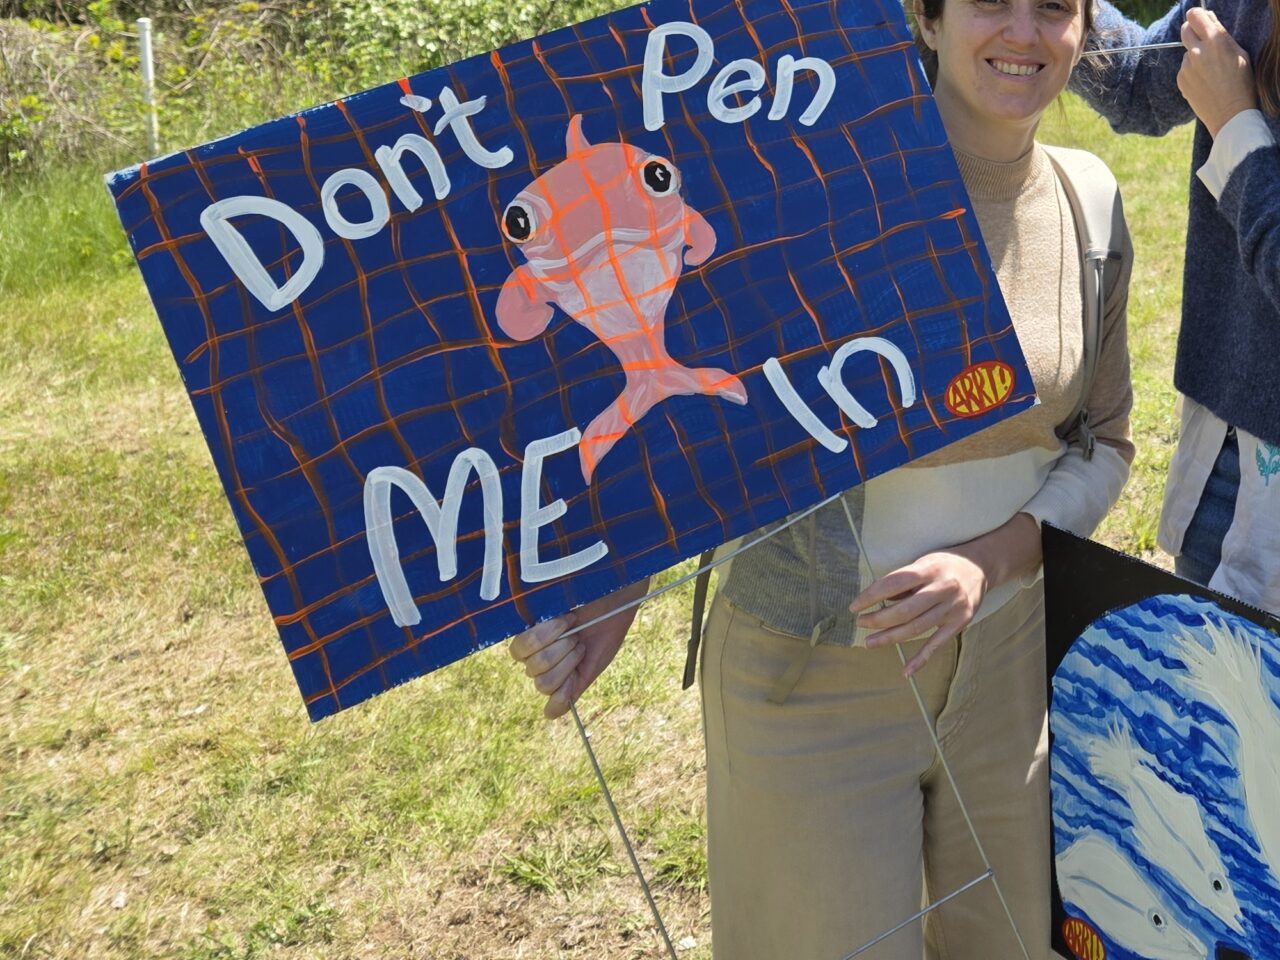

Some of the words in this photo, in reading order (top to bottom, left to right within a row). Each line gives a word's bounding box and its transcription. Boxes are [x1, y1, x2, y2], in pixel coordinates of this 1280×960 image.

[200, 84, 513, 311] Don't
[642, 21, 837, 131] Pen
[362, 428, 608, 628] ME
